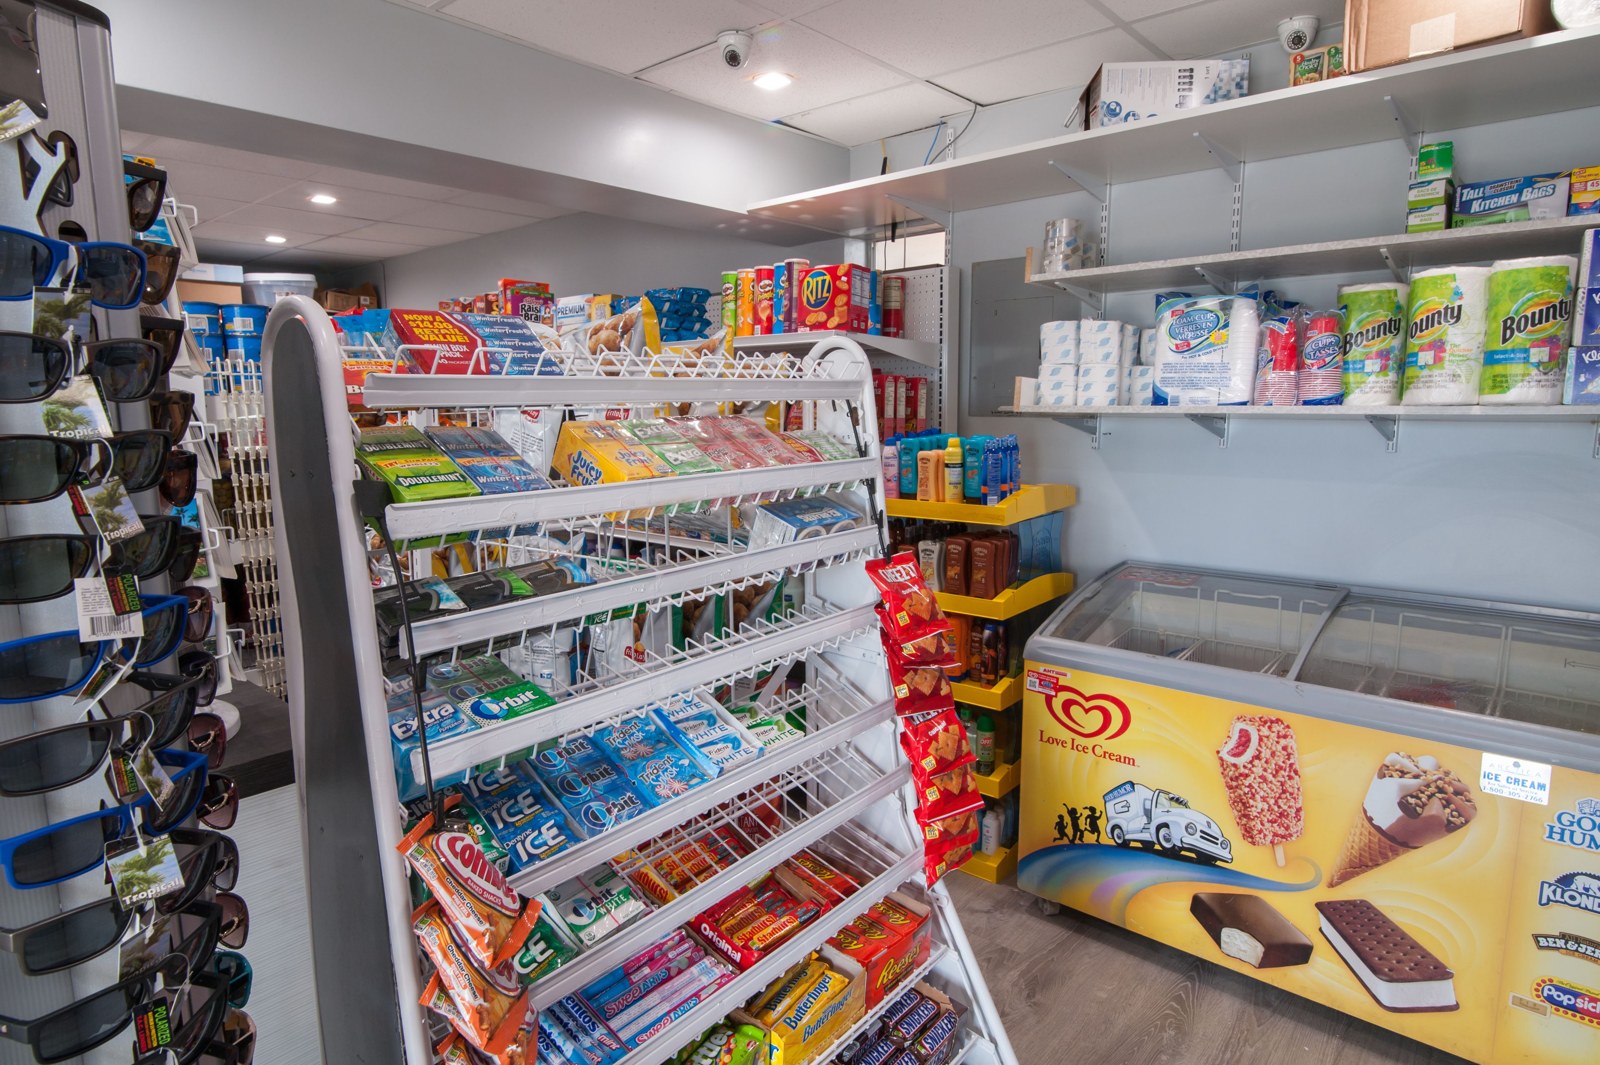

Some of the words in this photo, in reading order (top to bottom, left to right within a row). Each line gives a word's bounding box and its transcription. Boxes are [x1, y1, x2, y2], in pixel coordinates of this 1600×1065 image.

[0, 119, 40, 141] opical
[1461, 186, 1485, 202] TALL
[1470, 193, 1519, 214] KITCHEN
[1520, 184, 1556, 201] BAGS
[802, 275, 830, 307] RITZ
[403, 313, 432, 321] NOW
[524, 312, 540, 321] Bra
[557, 304, 585, 316] PREMIUM
[1409, 303, 1463, 340] ounty
[1500, 298, 1572, 346] Bounty
[409, 321, 453, 330] $14.00
[414, 328, 465, 336] RETAIL
[420, 335, 470, 343] VALUE!
[1341, 316, 1402, 356] Bounty
[1581, 349, 1600, 364] Kle
[364, 441, 427, 452] DOUBLEMINT
[397, 472, 464, 488] DOUBLEMINT
[476, 473, 538, 484] Winterfresh
[571, 450, 602, 480] Juicy
[104, 520, 144, 541] Tropical
[121, 573, 141, 611] POLARIZED
[470, 690, 540, 721] Orbit
[689, 723, 729, 743] WHITE
[762, 728, 798, 748] WHITE
[1038, 729, 1068, 749] Love
[1070, 737, 1089, 754] Ice
[1091, 743, 1136, 767] Cream
[534, 738, 591, 770] Orbit
[712, 746, 754, 768] WHITE
[557, 763, 616, 798] Orbit
[638, 754, 675, 785] Trident
[1482, 771, 1502, 782] ICE
[1505, 775, 1547, 792] CREAM
[491, 788, 542, 830] ICE
[581, 791, 641, 830] Orbit
[504, 827, 533, 849] Dentyne
[515, 819, 569, 860] ICE
[1545, 824, 1600, 850] HUM
[122, 876, 182, 906] Tropical
[446, 876, 468, 902] Cheddar
[465, 901, 485, 927] Cheese
[467, 878, 483, 893] BAKED
[482, 889, 502, 905] SNACKS
[700, 923, 742, 963] Original
[757, 915, 798, 946] Starburst
[513, 931, 555, 975] CE
[1537, 936, 1567, 951] BEN
[1578, 943, 1600, 961] JER
[447, 944, 469, 974] Cheddar
[464, 972, 479, 1000] Cheese
[565, 995, 600, 1034] entos
[783, 972, 833, 1031] Butterfinger
[802, 989, 853, 1043] Butterfinger
[884, 988, 920, 1025] SNICKERS
[153, 1005, 172, 1046] POLARIZED
[898, 998, 938, 1039] SNICKERS
[921, 1010, 958, 1055] SNICKERS
[863, 1037, 897, 1065] NICKER
